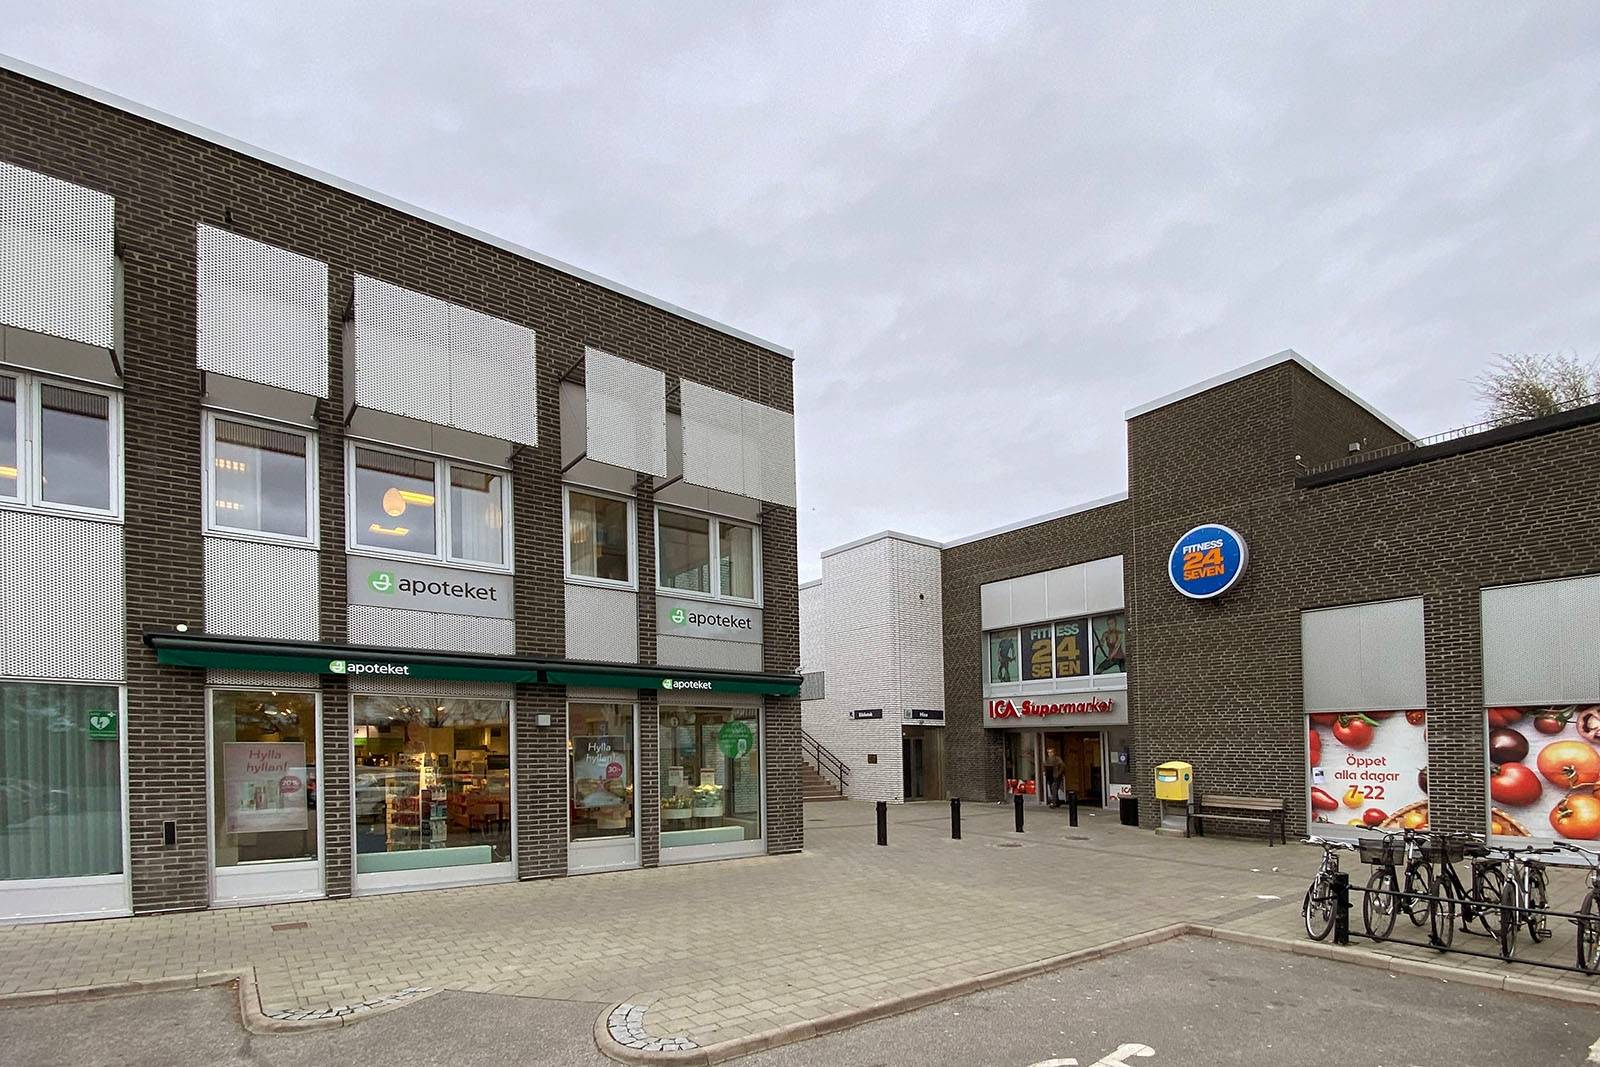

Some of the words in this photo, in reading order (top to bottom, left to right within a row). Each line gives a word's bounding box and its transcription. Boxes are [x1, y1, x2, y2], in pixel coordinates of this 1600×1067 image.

[1183, 539, 1223, 554] FITNESS
[1184, 548, 1224, 571] 24
[1184, 564, 1225, 581] SEVEN
[398, 578, 497, 601] apoteket
[688, 612, 752, 629] apoteket
[1031, 635, 1080, 663] 24
[347, 662, 410, 675] apoteket
[1031, 660, 1081, 678] SEEN
[672, 680, 712, 690] apoteket
[989, 699, 1021, 719] ICA
[1021, 696, 1114, 717] Supermarket
[248, 749, 282, 761] Hylla
[588, 742, 612, 753] Hylla
[246, 762, 288, 774] hyllan!
[1346, 753, 1387, 768] Öppet
[1334, 770, 1357, 780] alla
[1360, 770, 1400, 783] dagar
[1349, 785, 1385, 800] 7-22
